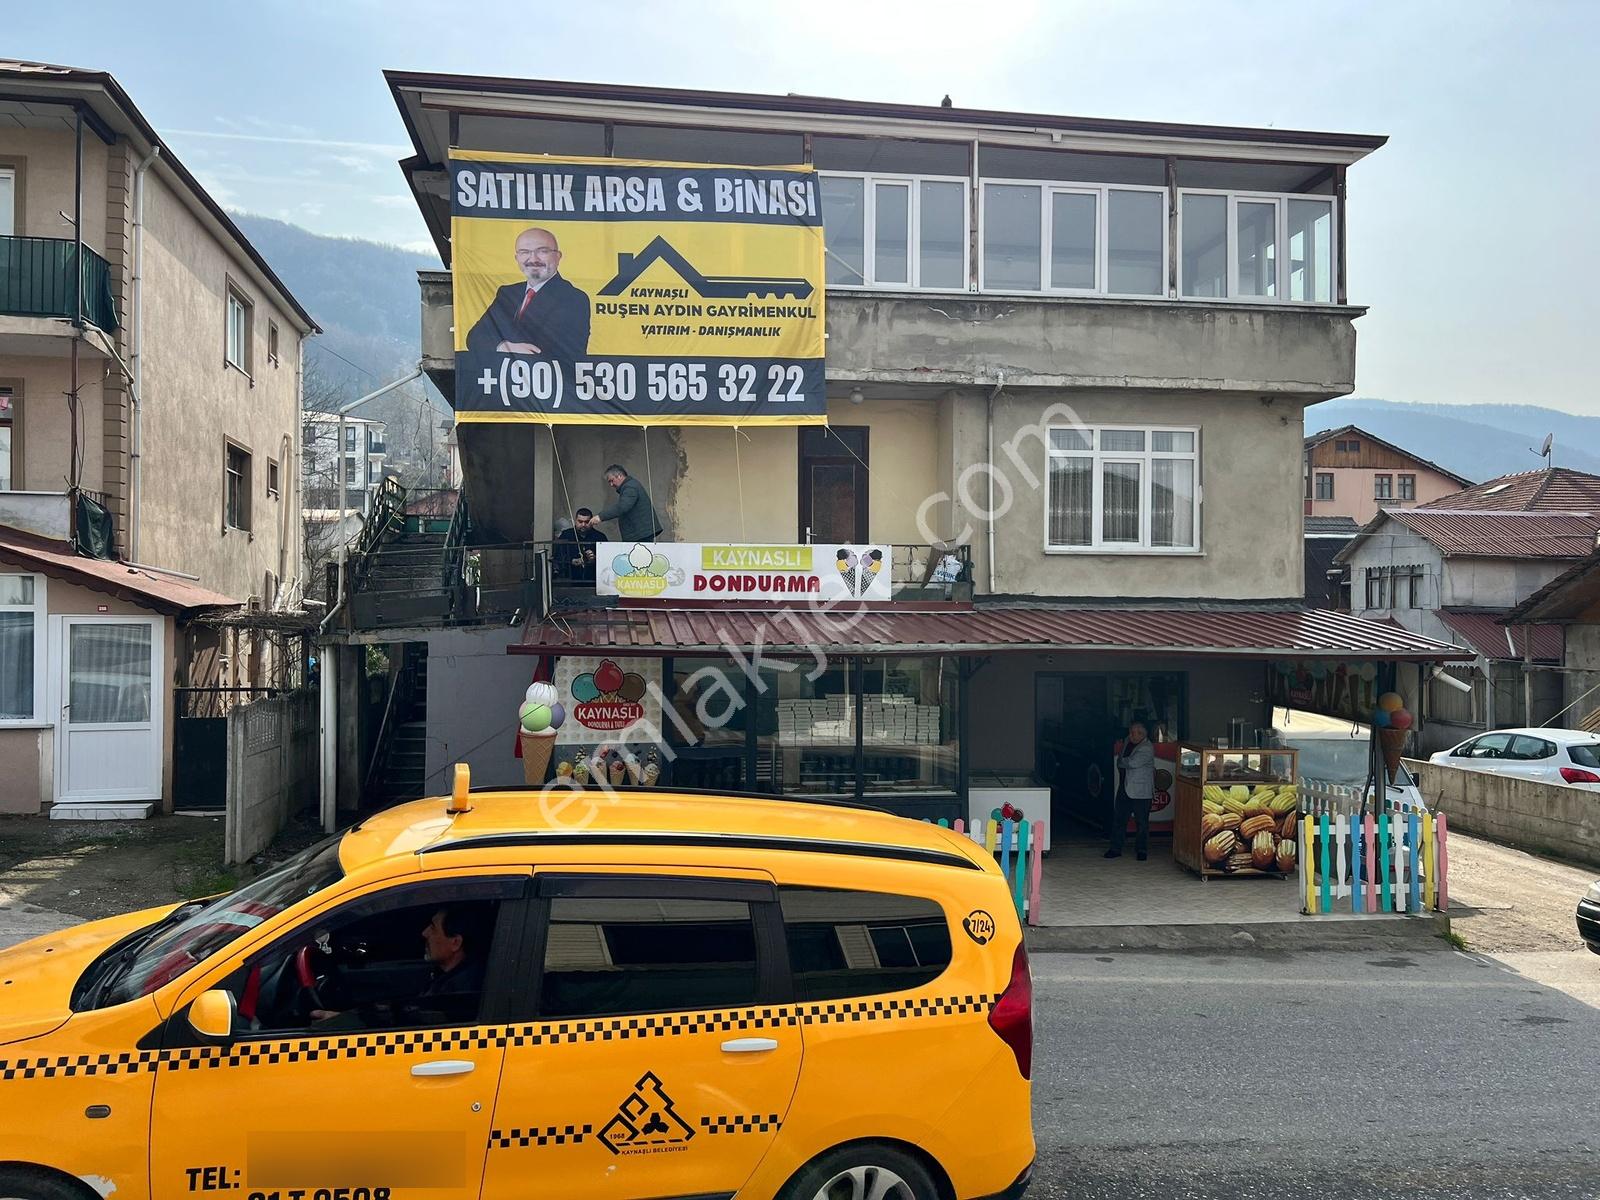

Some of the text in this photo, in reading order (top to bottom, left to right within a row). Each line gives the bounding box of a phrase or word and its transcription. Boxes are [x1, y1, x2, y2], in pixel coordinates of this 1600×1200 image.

[456, 170, 575, 212] SATILIK
[584, 175, 667, 213] ARSA
[676, 177, 704, 212] &
[630, 287, 689, 300] KAYNAŞLI
[595, 302, 816, 319] RUŞEN AYDIN GAYRİMENKUL
[641, 325, 690, 336] YATIRIM
[698, 325, 781, 339] DANIŞMANLIK
[477, 357, 805, 408] +(90) 530 565 32 22
[693, 574, 821, 593] DONDURMA
[578, 706, 640, 720] KAYNAŞLI
[971, 918, 991, 934] 7/24
[185, 1166, 241, 1192] TEL:
